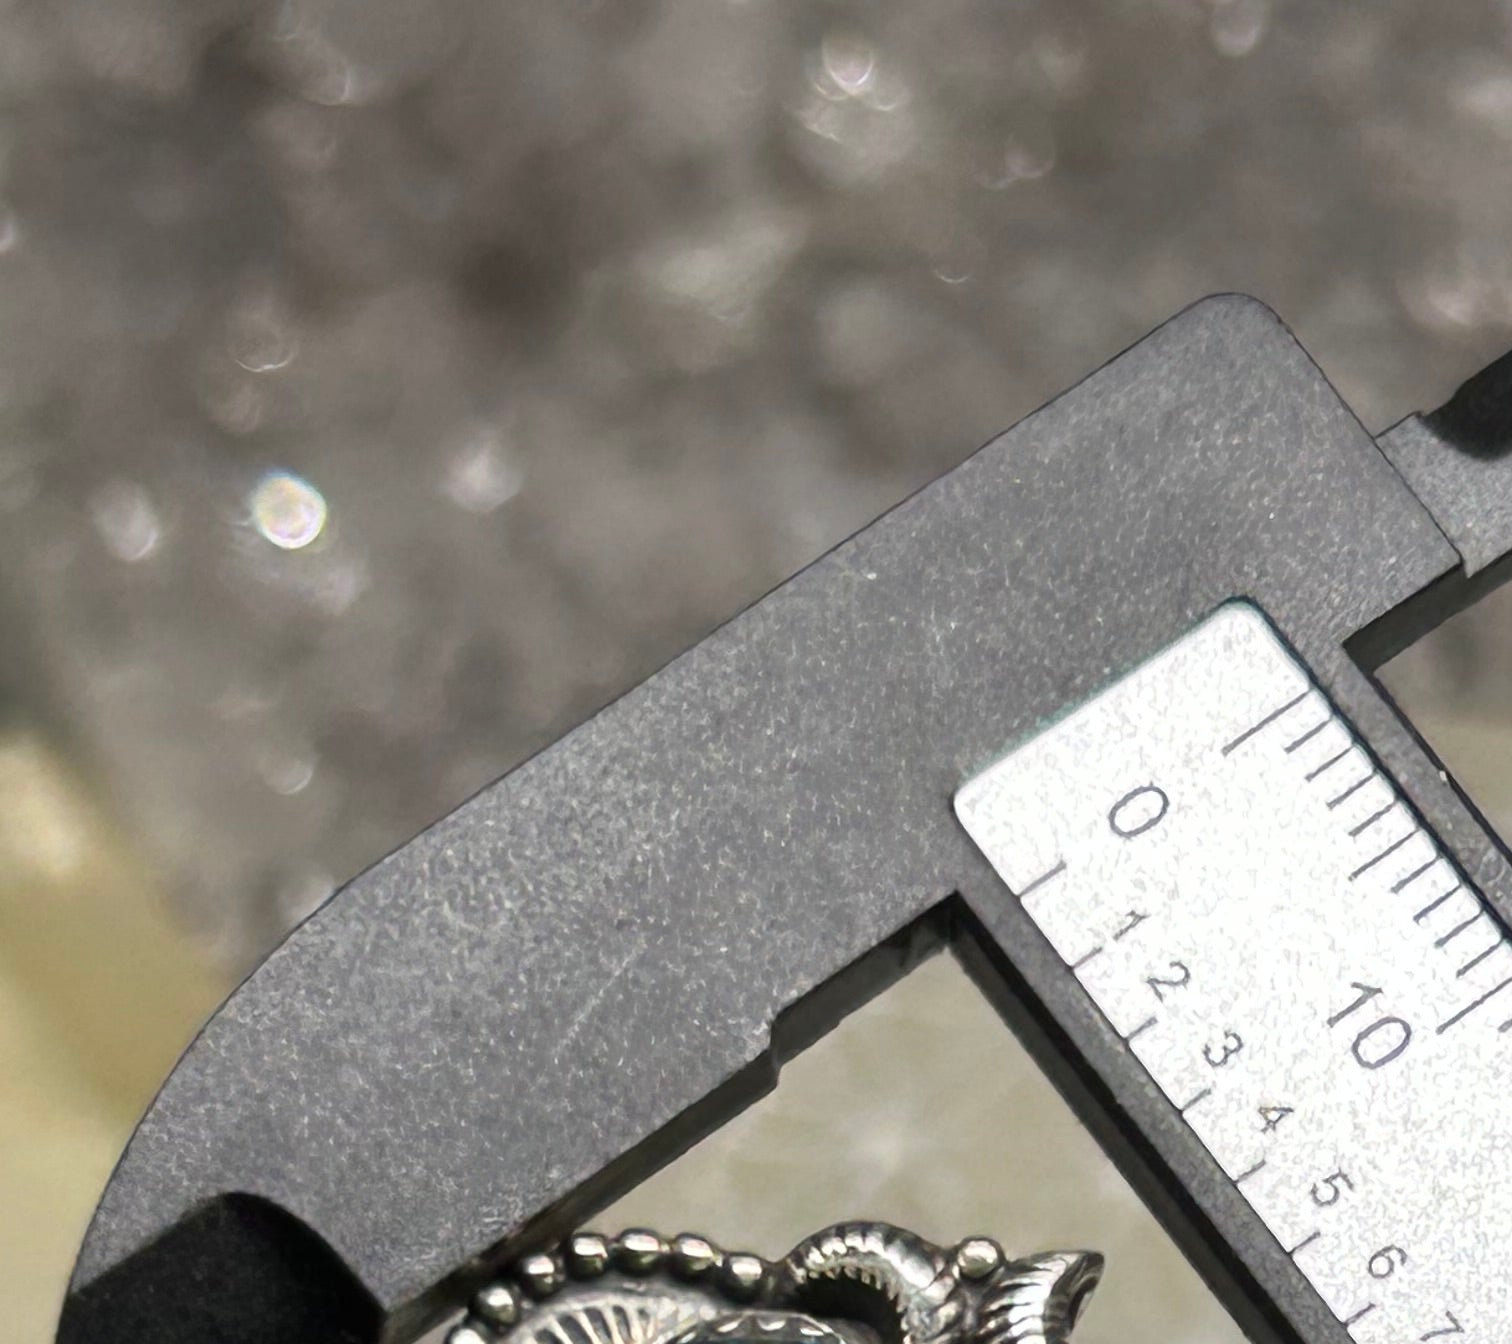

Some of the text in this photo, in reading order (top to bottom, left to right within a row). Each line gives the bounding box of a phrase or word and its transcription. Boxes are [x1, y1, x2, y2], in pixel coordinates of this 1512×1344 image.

[1109, 783, 1169, 838] 0
[1328, 980, 1413, 1070] 10
[1114, 910, 1147, 940] 1
[1147, 961, 1192, 1001] 2
[1203, 1033, 1243, 1069] 3
[1258, 1102, 1295, 1134] 4
[1310, 1168, 1355, 1207] 5
[1368, 1245, 1407, 1280] 6
[1420, 1311, 1466, 1344] 7
